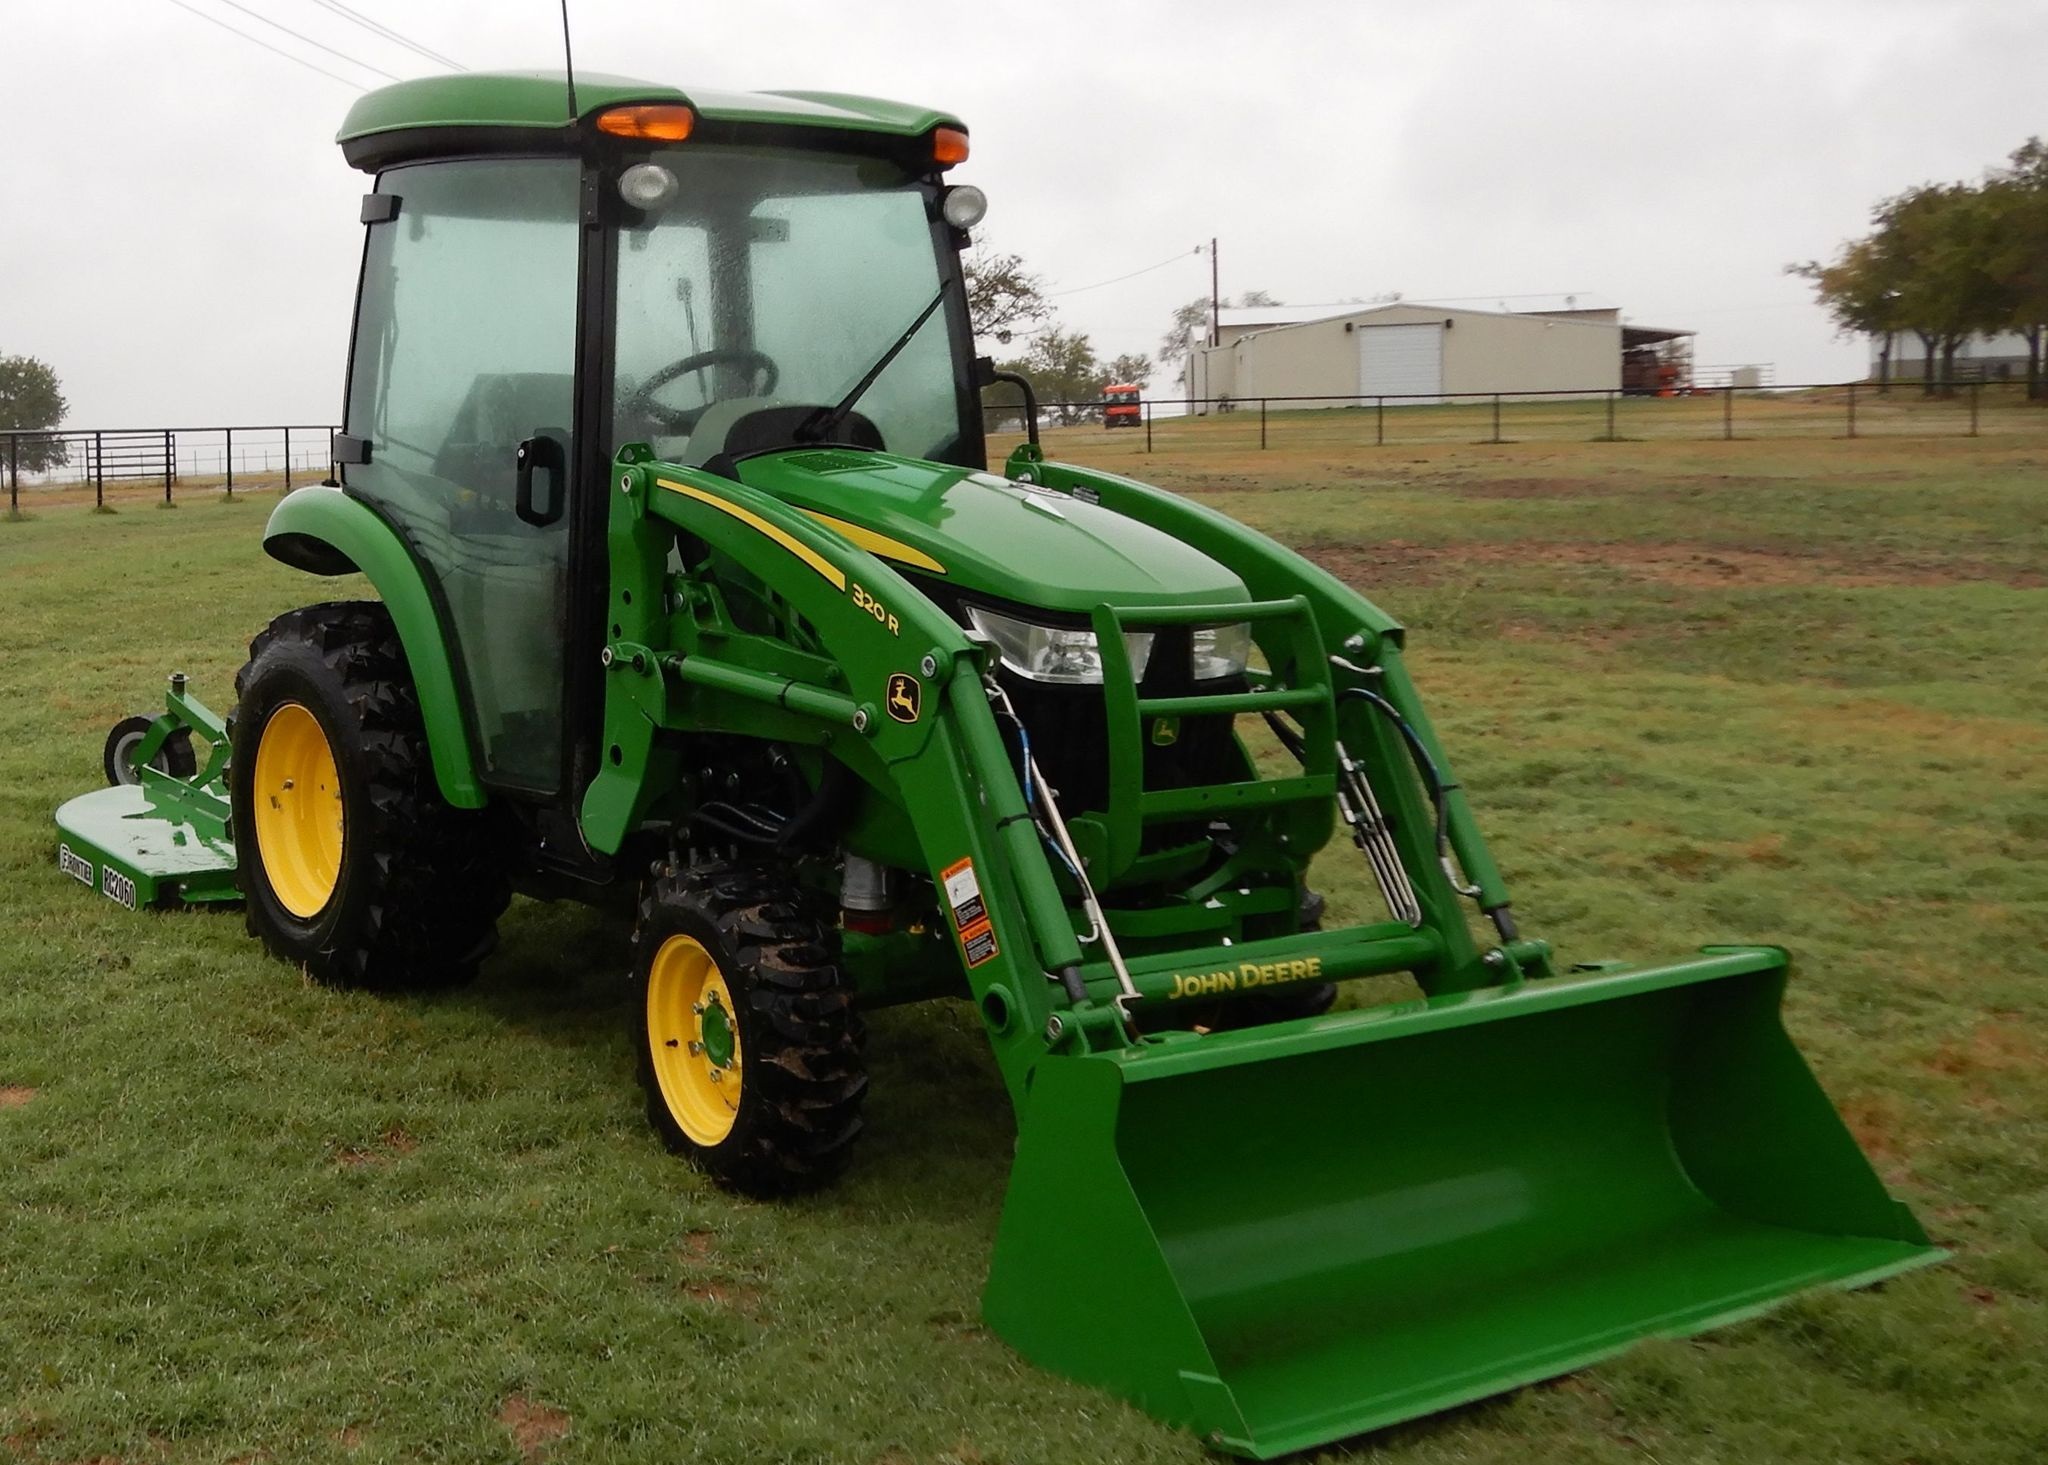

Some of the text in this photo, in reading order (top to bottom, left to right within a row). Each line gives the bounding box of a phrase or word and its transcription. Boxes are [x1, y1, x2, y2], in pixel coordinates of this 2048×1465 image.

[853, 583, 899, 636] 320 R
[61, 845, 93, 885] FRONTIER
[103, 867, 135, 909] RC2060
[1168, 957, 1322, 1000] JOHN DEERE
